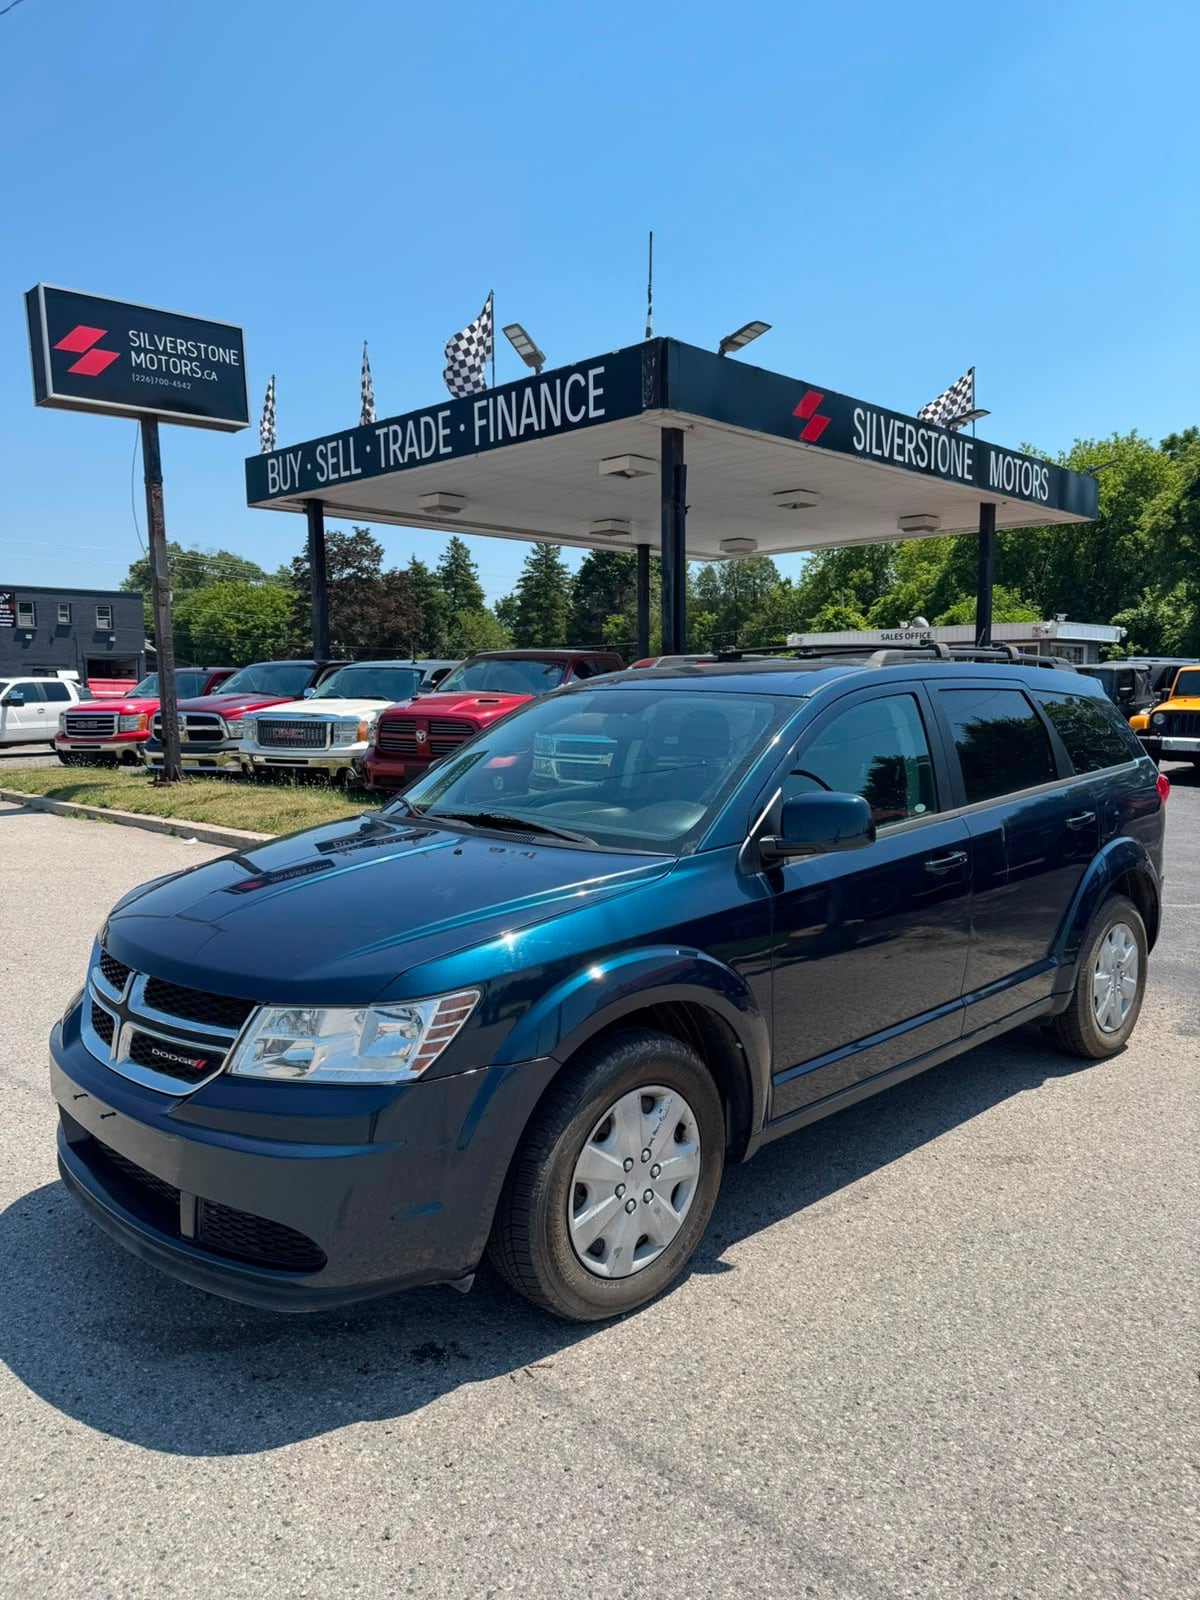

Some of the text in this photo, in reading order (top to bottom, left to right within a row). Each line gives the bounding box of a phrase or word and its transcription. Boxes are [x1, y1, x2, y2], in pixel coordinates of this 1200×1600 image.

[128, 329, 240, 366] SILVERSTONE
[130, 350, 218, 382] MOTORS.CA
[131, 373, 192, 390] (226)700-4542
[267, 366, 606, 494] BUY SELL TRADE FINANCE
[852, 407, 1049, 501] SILVERSTONE MOTORS
[880, 631, 932, 641] SALES OFFICE
[151, 1048, 197, 1067] DODGE
